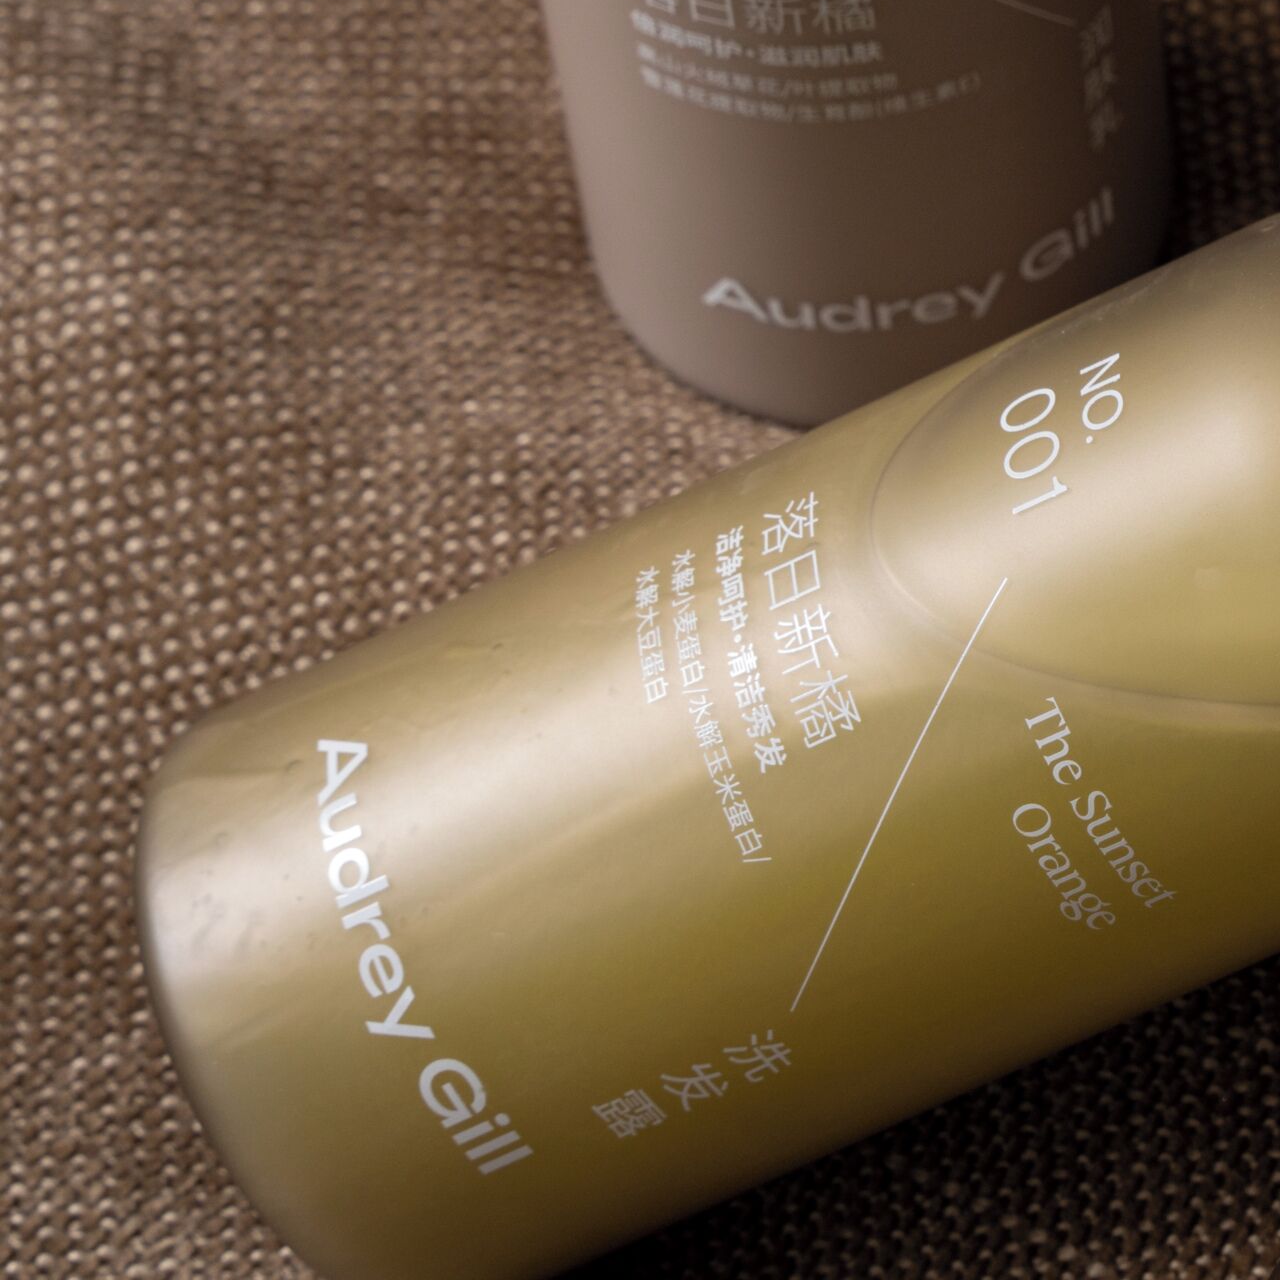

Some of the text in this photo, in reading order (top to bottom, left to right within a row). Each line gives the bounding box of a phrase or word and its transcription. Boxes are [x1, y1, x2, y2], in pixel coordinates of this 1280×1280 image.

[703, 186, 1116, 333] Audrey Gill
[999, 387, 1068, 516] 001
[1079, 352, 1124, 444] NO.
[761, 491, 862, 749] 落日新橘
[1011, 802, 1117, 931] Orange
[1024, 696, 1178, 909] The Sunset
[316, 738, 535, 1176] Audrey Gill
[591, 1028, 793, 1140] 洗发露
